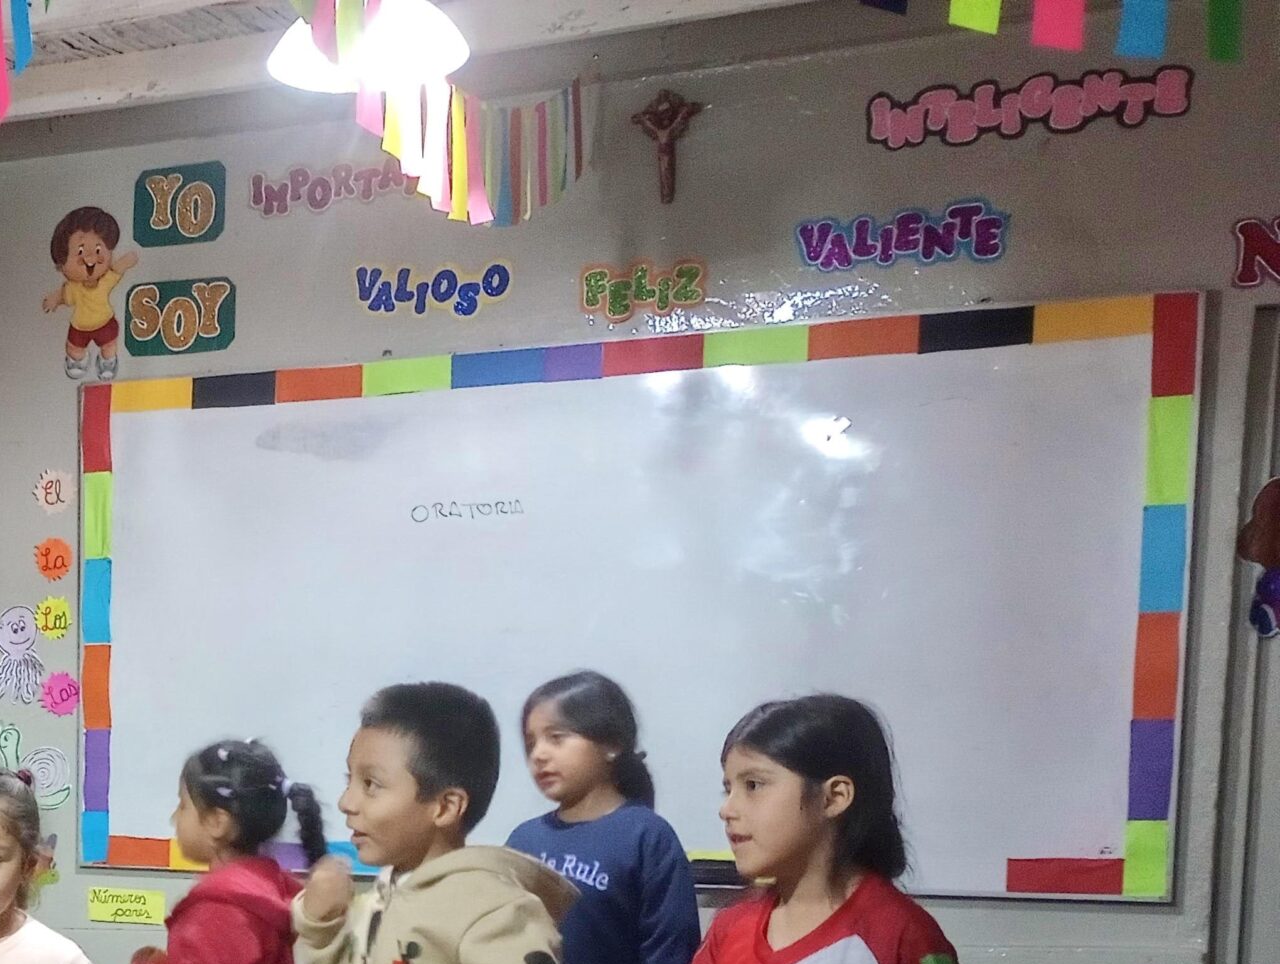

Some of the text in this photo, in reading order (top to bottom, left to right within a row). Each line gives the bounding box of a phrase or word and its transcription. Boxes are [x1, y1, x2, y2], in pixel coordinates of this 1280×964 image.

[869, 67, 1191, 149] INTELIGENTE
[144, 174, 217, 238] YO
[798, 201, 1004, 272] VALIENTE
[355, 263, 511, 317] VALIOSO
[583, 264, 703, 318] FELIZ
[127, 281, 230, 351] SOY
[42, 478, 66, 506] El
[409, 499, 525, 524] ORATORIA
[40, 546, 68, 572] La
[40, 606, 71, 632] Los
[45, 683, 78, 710] Las
[561, 853, 610, 891] Rule
